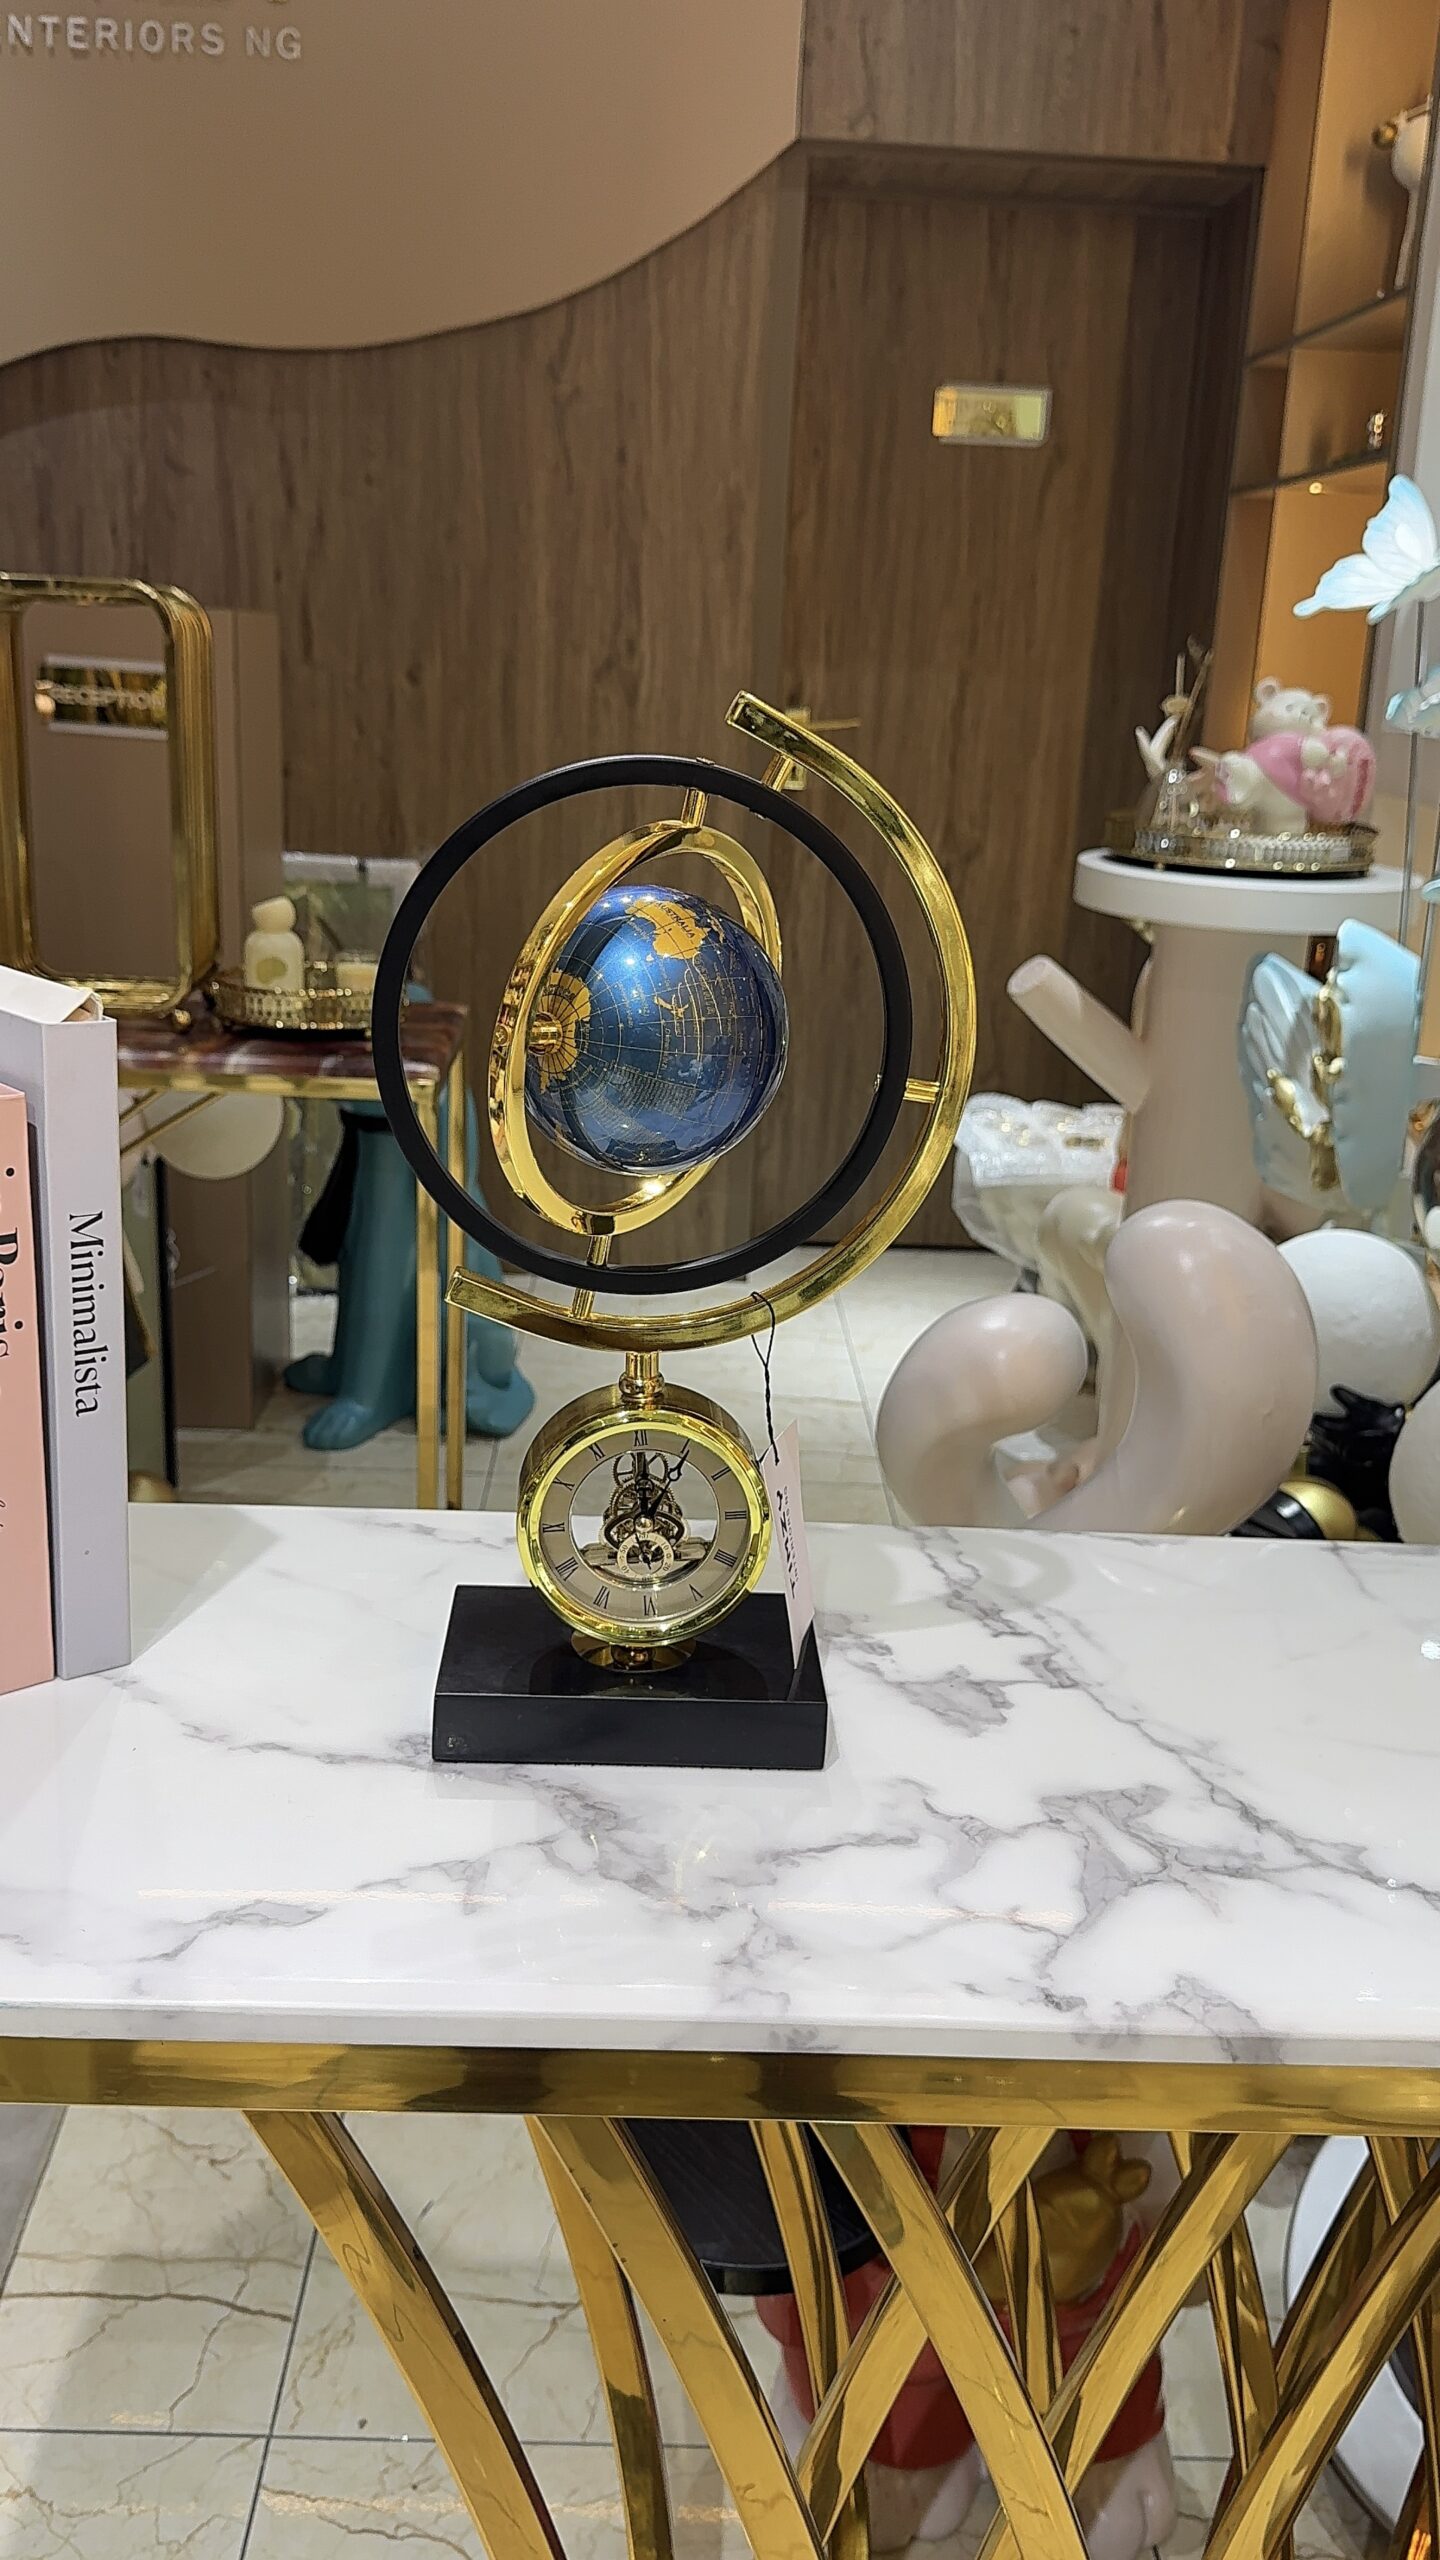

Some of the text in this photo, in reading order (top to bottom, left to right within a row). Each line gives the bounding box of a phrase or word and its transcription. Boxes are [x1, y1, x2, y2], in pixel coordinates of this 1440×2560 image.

[7, 13, 301, 60] NTERIORS NG
[69, 1210, 109, 1417] Minimalista
[633, 1430, 648, 1447] XII
[588, 1442, 606, 1462] XI
[711, 1466, 732, 1481] II
[552, 1476, 576, 1492] X
[724, 1510, 747, 1520] III
[542, 1521, 565, 1534] IX
[554, 1556, 579, 1582] VIII
[592, 1585, 611, 1610] VII
[689, 1583, 705, 1602] V
[643, 1594, 657, 1616] VI
